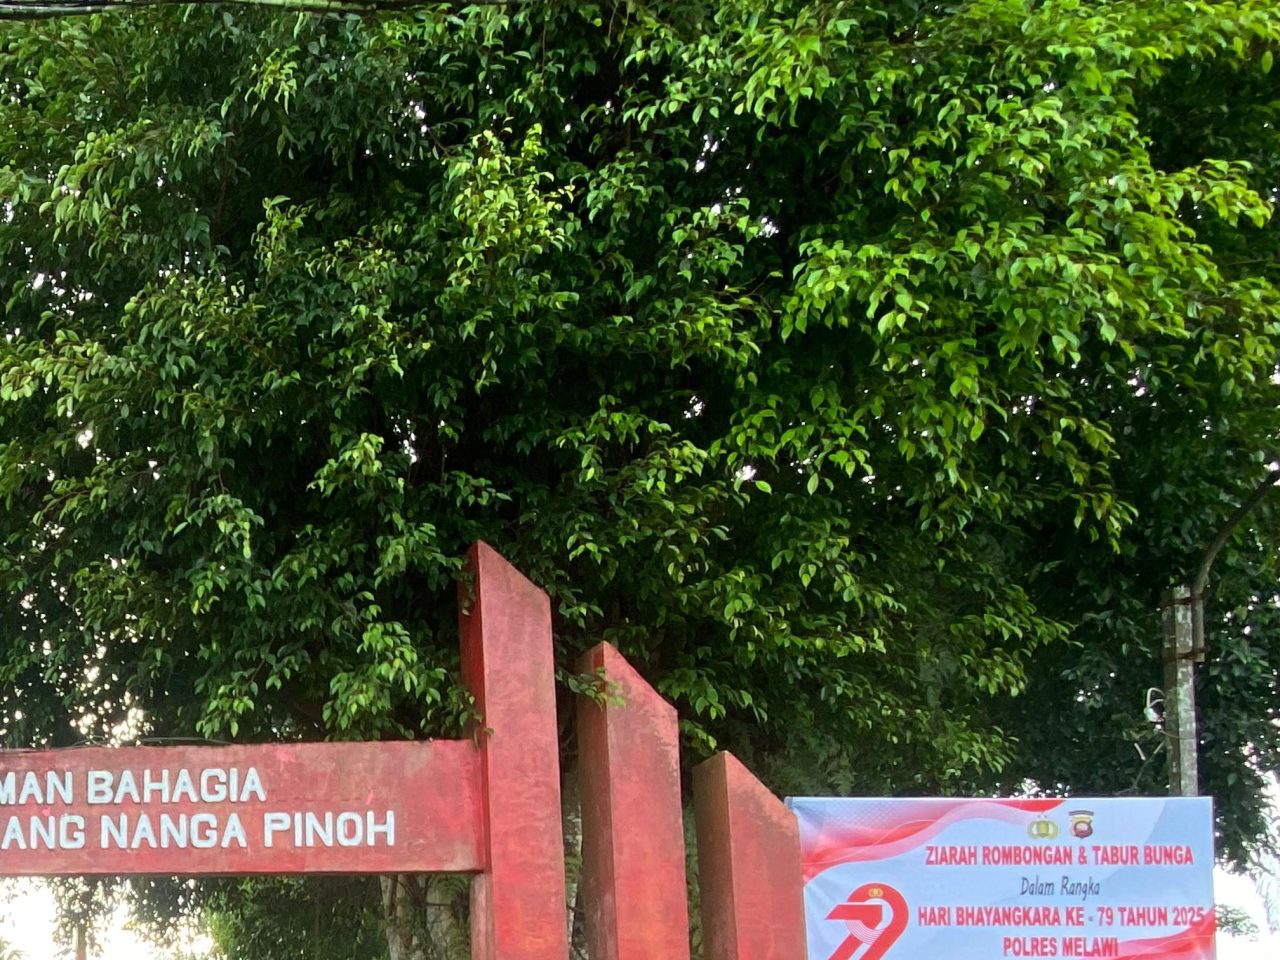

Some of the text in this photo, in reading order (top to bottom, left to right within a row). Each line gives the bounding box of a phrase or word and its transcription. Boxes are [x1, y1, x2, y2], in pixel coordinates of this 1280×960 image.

[87, 767, 266, 804] BAHAGIA
[101, 812, 248, 848] NANGA
[264, 810, 395, 848] PINOH
[925, 845, 1194, 866] ZIARAH ROMBONGAN & TABUR BUNGA
[1020, 875, 1101, 901] Dalam Rangka
[918, 906, 951, 926] HARI
[956, 906, 1061, 926] BHAYANGKARA
[1065, 906, 1085, 926] KE
[1097, 906, 1114, 927] 79
[1118, 906, 1168, 926] TAHUN
[1172, 906, 1205, 926] 2025
[1003, 937, 1118, 957] POLRES MELAWI
